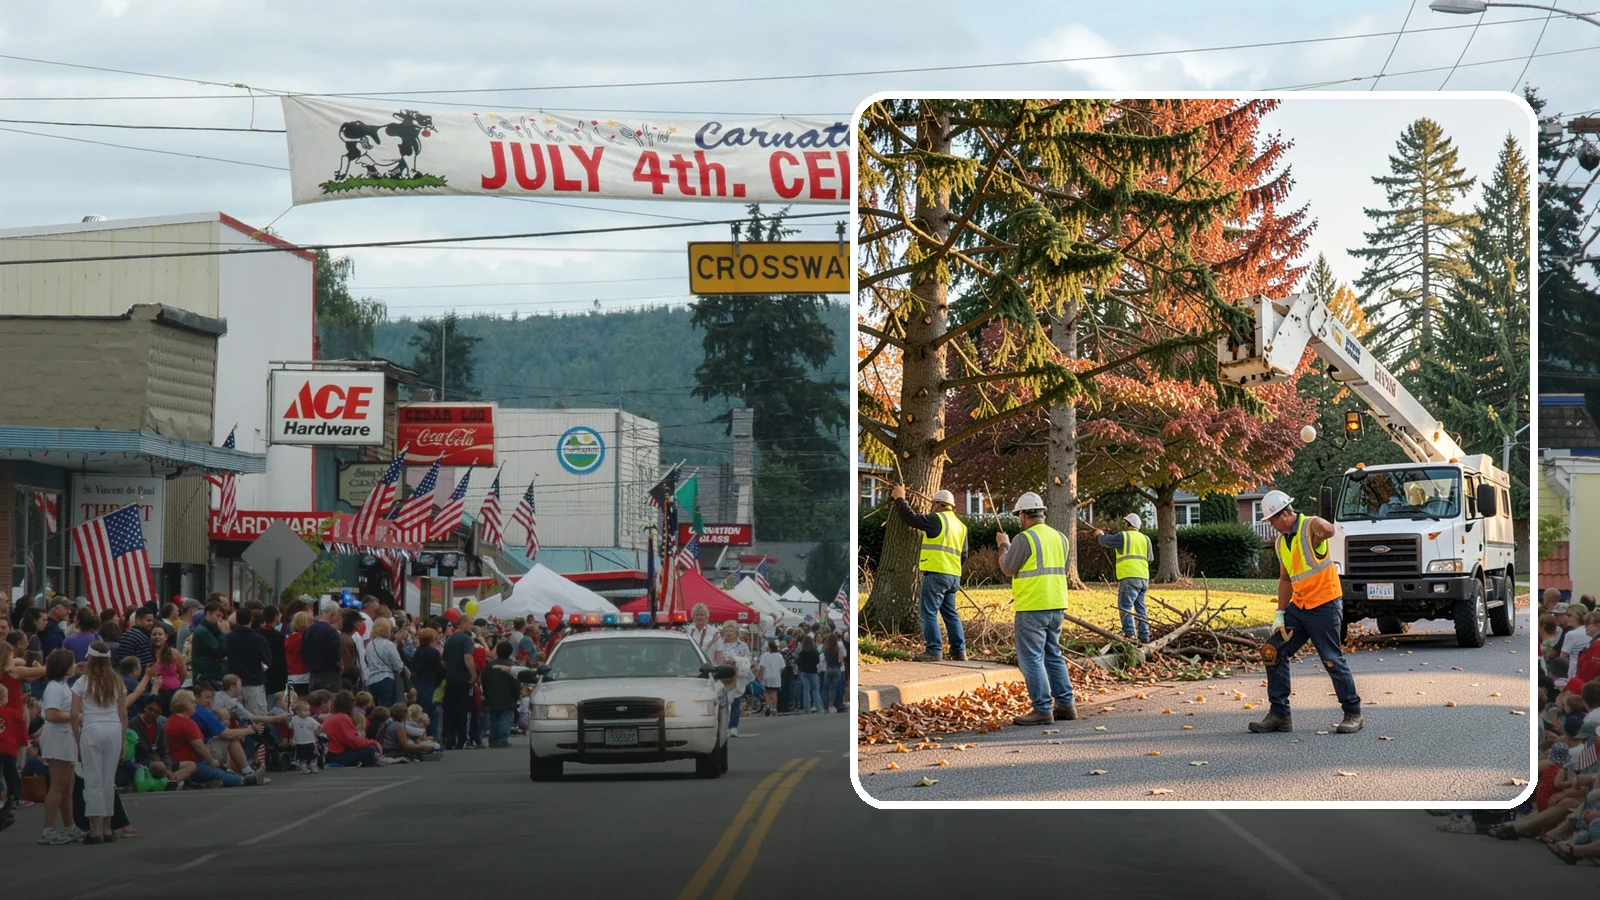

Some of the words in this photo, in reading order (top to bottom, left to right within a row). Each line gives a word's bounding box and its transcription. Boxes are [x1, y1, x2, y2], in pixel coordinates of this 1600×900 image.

[482, 140, 604, 192] JULY
[632, 150, 746, 198] 4th.
[697, 254, 850, 280] CROSSWA
[283, 380, 373, 420] ACE
[405, 409, 452, 422] CEDAR
[284, 421, 370, 436] Hardware
[353, 467, 385, 479] Simpl
[95, 485, 124, 494] Vincent
[126, 486, 135, 494] de
[138, 486, 155, 495] Paul
[81, 503, 153, 522] THT
[213, 516, 330, 535] HRDARE
[688, 526, 741, 535] CRNATION
[699, 535, 730, 543] GLASS
